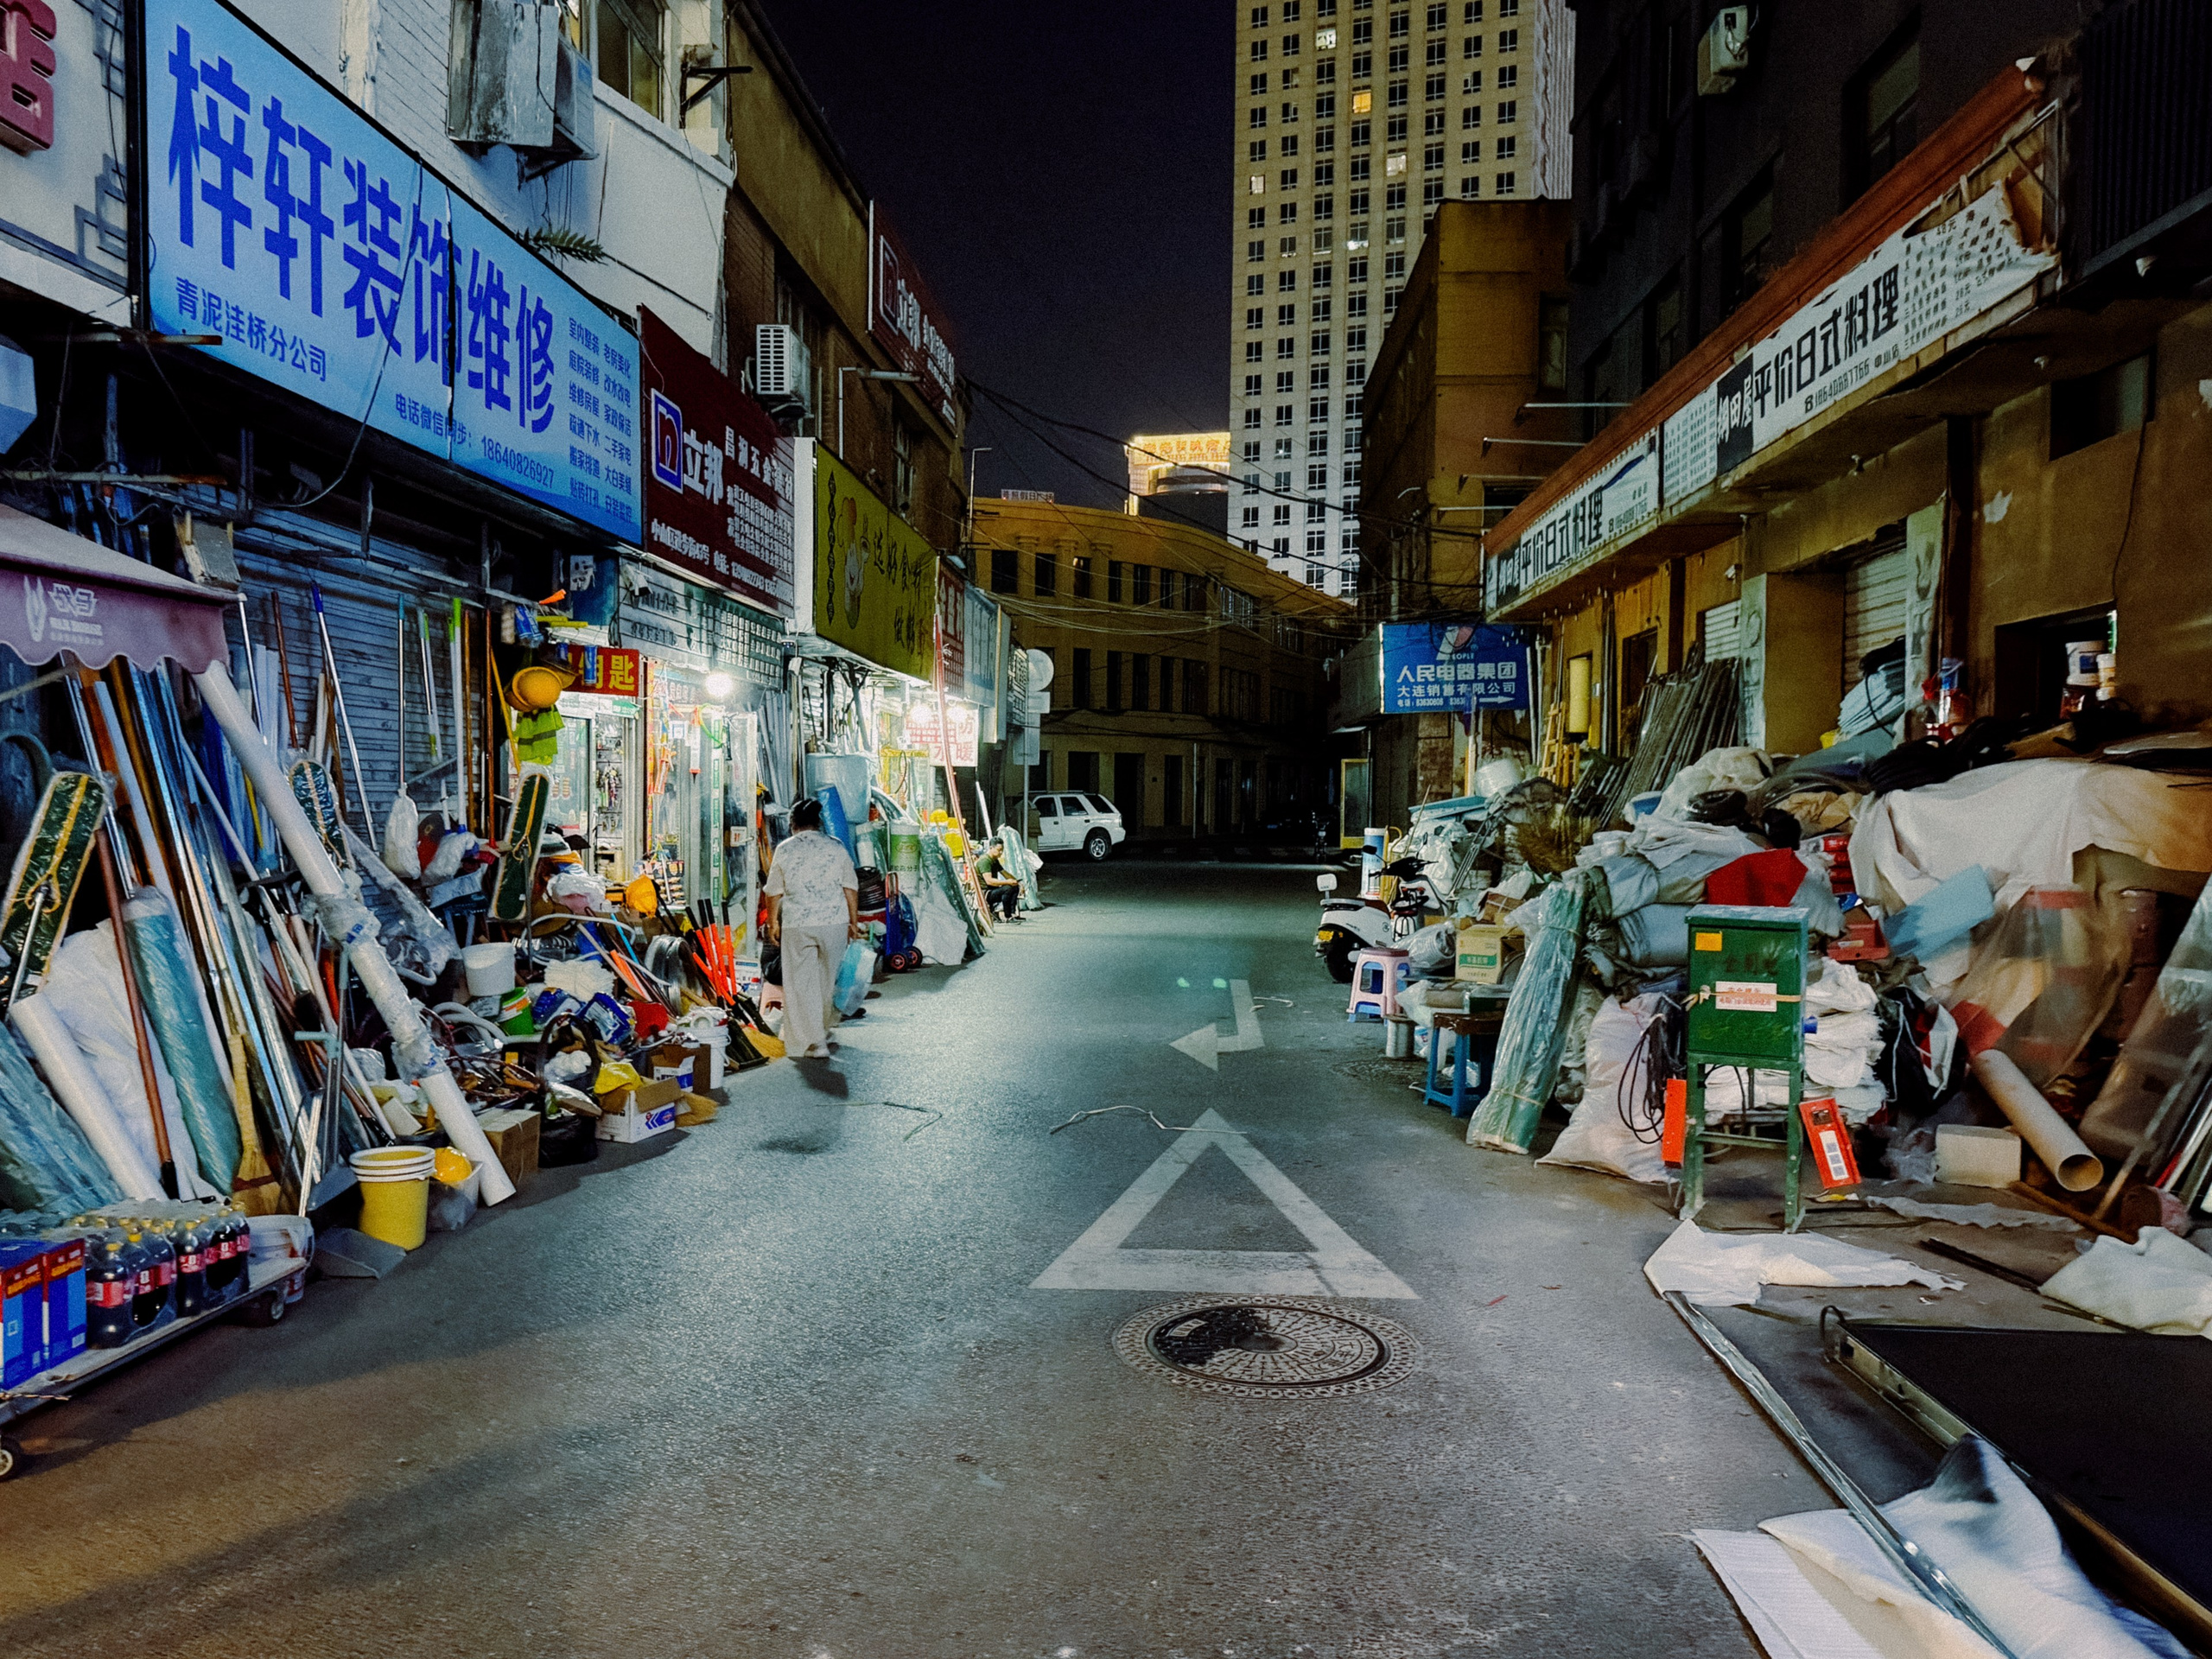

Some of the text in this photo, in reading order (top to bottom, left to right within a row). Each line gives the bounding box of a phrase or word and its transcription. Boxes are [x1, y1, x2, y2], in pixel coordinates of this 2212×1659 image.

[168, 24, 556, 434] 梓轩装饰维修
[175, 276, 326, 382] 青泥洼桥分公司
[1755, 264, 1899, 419] 平价日式料理
[481, 435, 555, 488] 18640826927
[604, 435, 632, 467] 二手家电
[683, 429, 724, 505] 立邦
[1522, 486, 1603, 586] 平价日式料理
[1396, 662, 1517, 683] 人民电器集团
[1396, 681, 1516, 698] 大连销售有限公司
